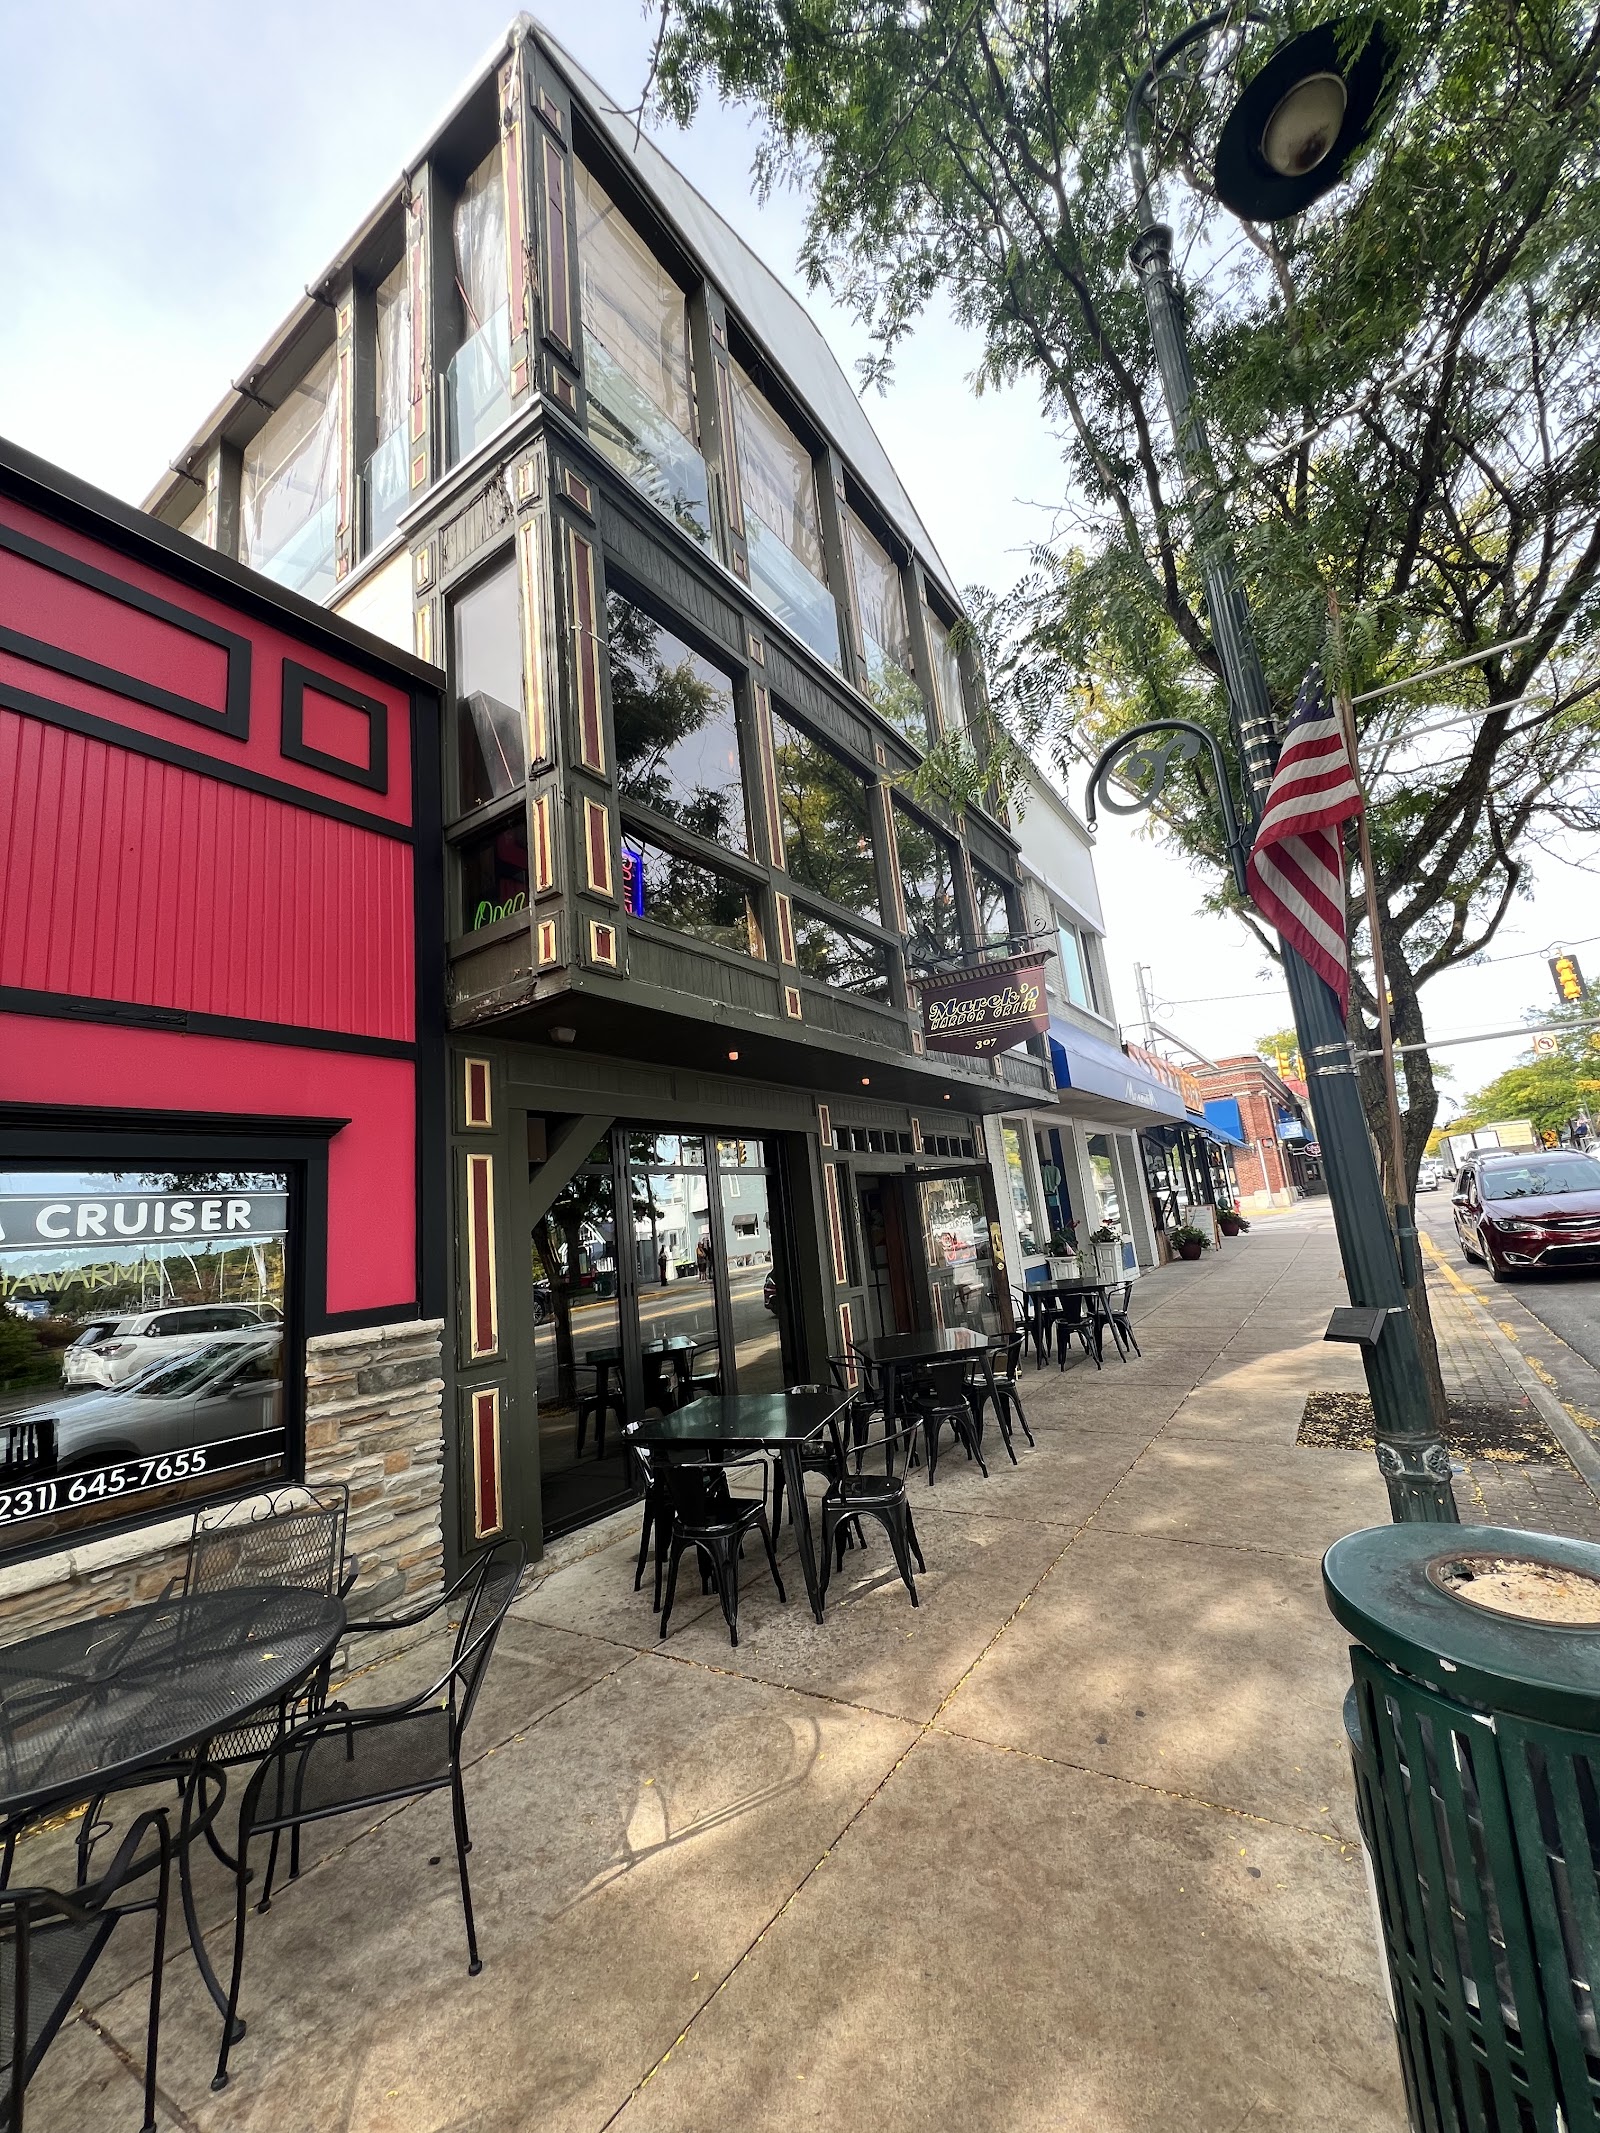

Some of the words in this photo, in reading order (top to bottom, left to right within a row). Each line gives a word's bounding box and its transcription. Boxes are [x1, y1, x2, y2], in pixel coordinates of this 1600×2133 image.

[929, 983, 1040, 1021] Marek's
[931, 1010, 985, 1031] HARBOR
[993, 998, 1038, 1019] GRILL
[975, 1037, 998, 1050] 307
[36, 1199, 252, 1239] CRUISER
[68, 1450, 207, 1502] 645-7655
